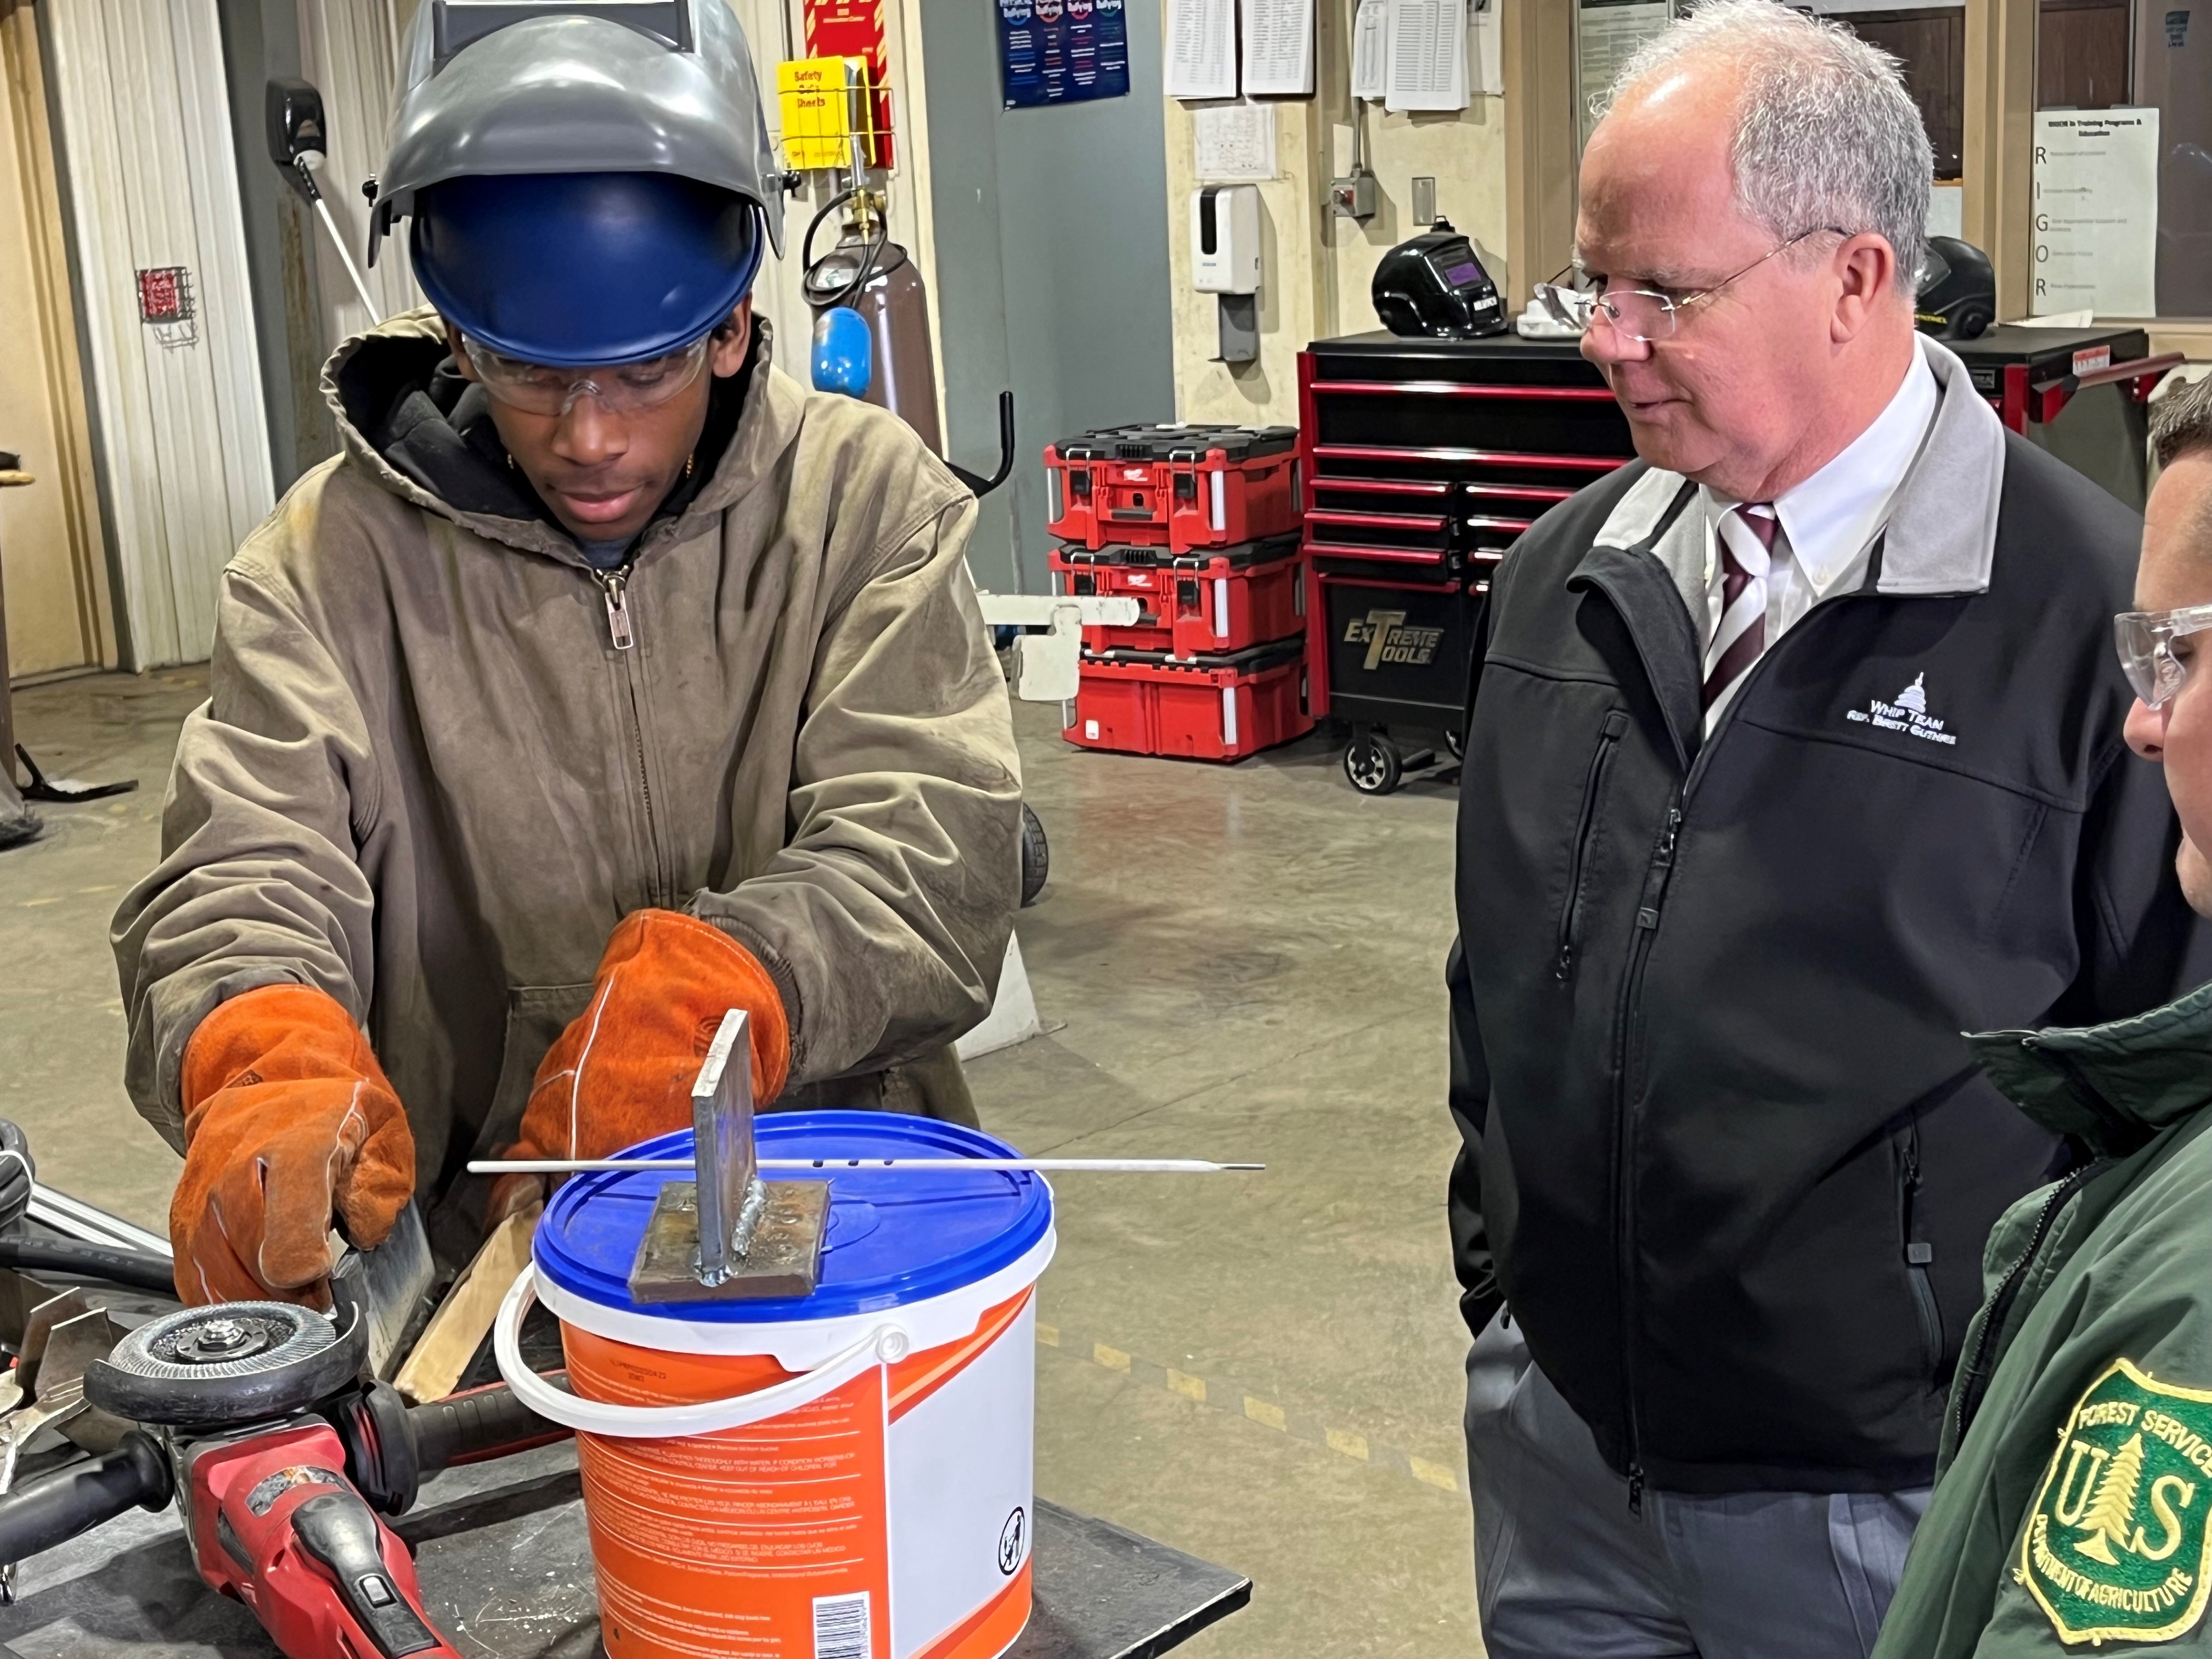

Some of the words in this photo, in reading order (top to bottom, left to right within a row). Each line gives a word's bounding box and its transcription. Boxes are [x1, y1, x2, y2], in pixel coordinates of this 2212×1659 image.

[794, 71, 822, 82] Safety
[2035, 146, 2046, 164] R
[2036, 182, 2040, 200] I
[2036, 213, 2049, 232] G
[2035, 245, 2049, 263] O
[2036, 278, 2046, 296] R
[1871, 700, 1905, 717] WHIP
[2078, 1402, 2140, 1429] FOREST
[2141, 1410, 2212, 1478] SERVICE
[2055, 1440, 2111, 1526] U
[2130, 1475, 2194, 1560] S
[2088, 1567, 2193, 1613] AGRICULTURE
